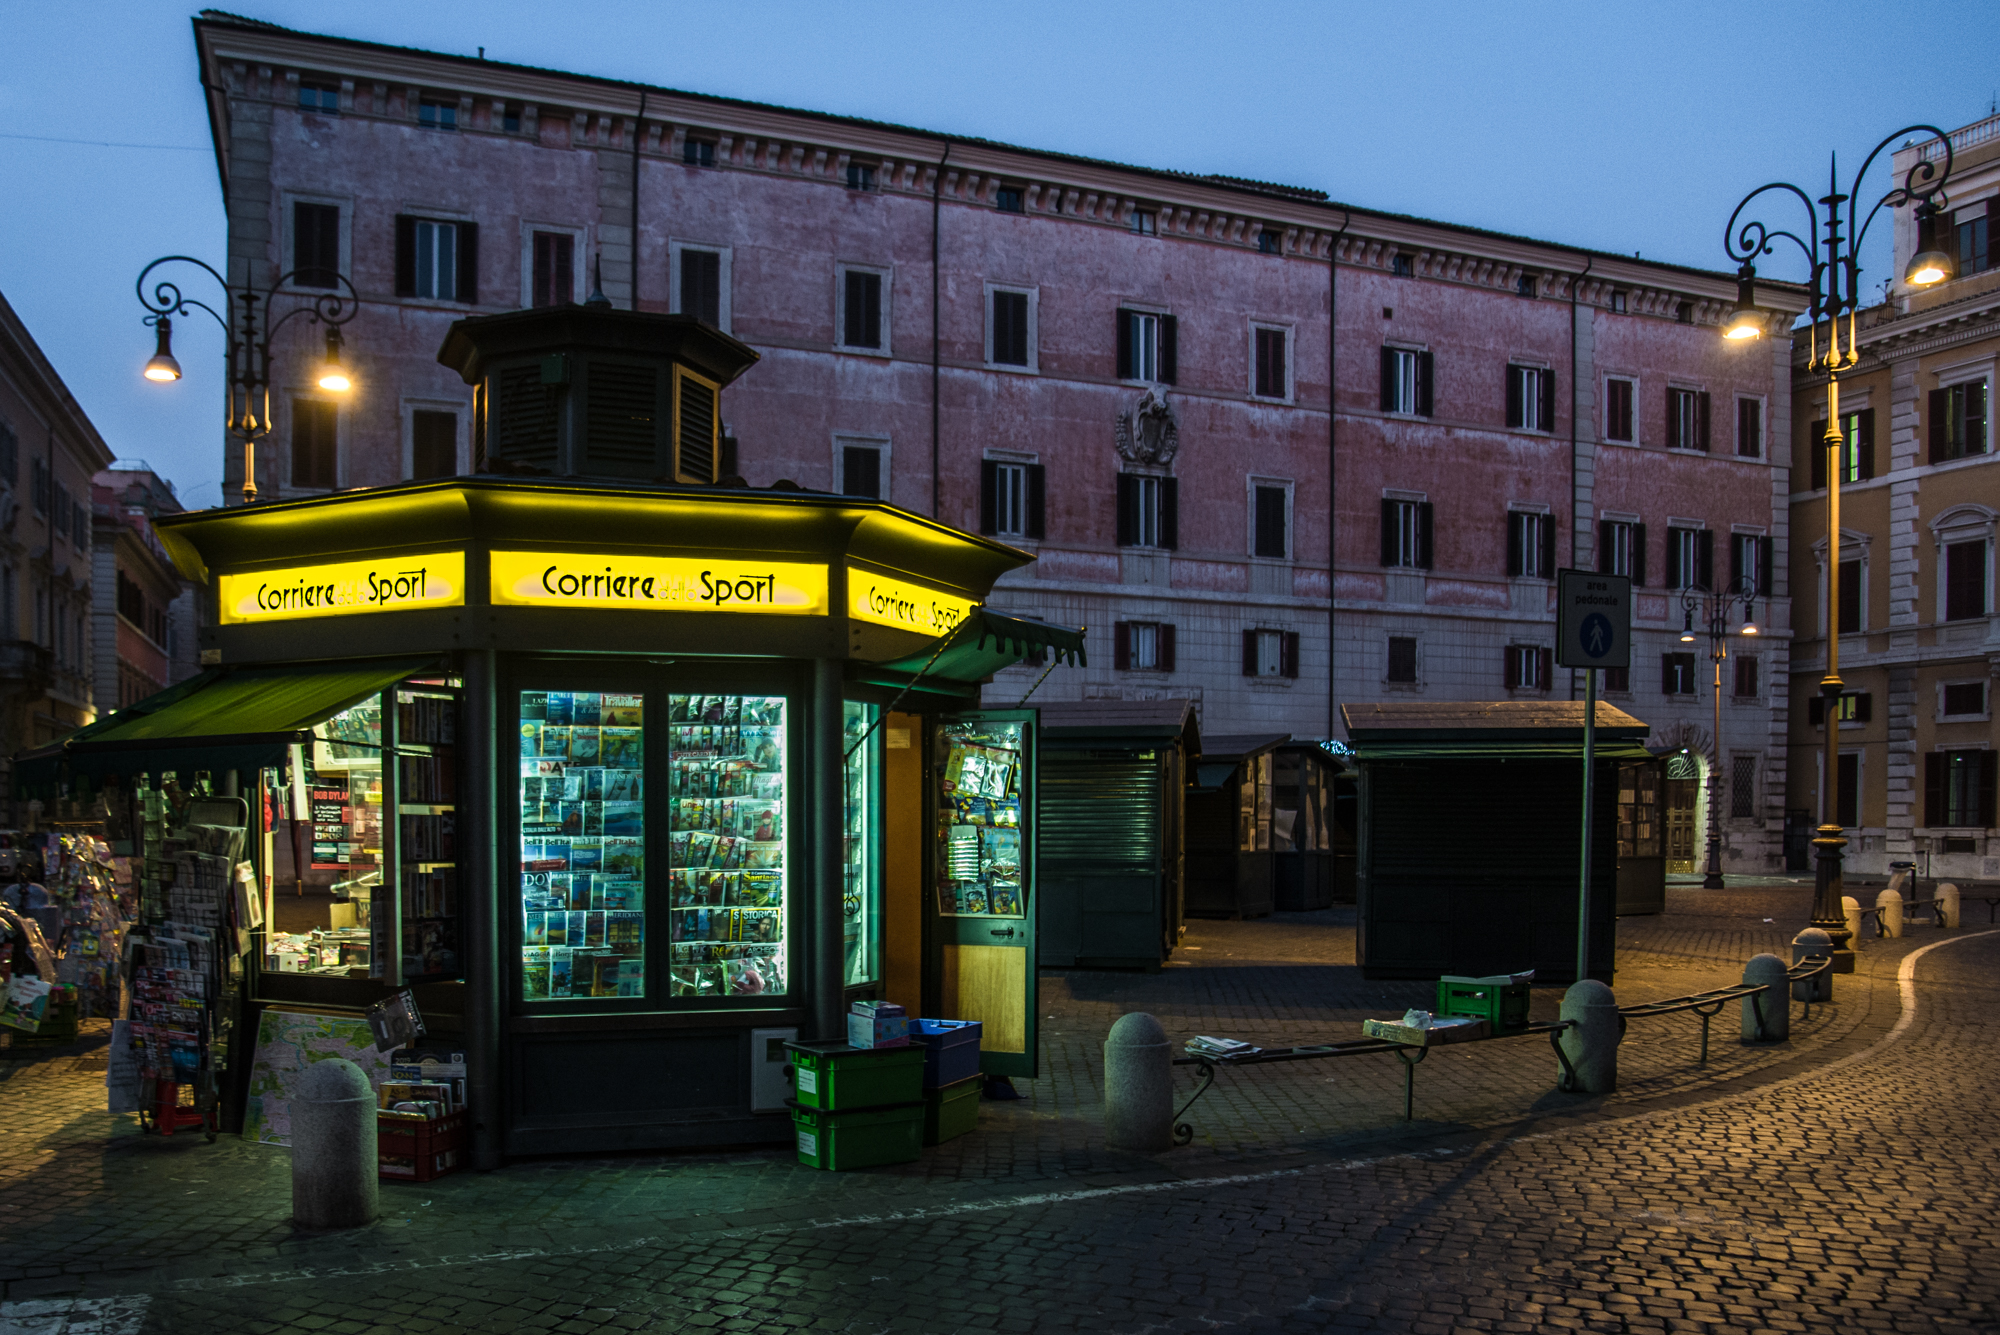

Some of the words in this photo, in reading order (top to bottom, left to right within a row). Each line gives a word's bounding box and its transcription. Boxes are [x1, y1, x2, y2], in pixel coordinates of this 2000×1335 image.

[258, 578, 334, 611] Corriere
[368, 567, 427, 606] Sport
[542, 565, 655, 599] Corriere
[700, 570, 775, 606] Sport
[1586, 581, 1608, 591] area
[1575, 595, 1619, 606] pedonale
[869, 585, 915, 622] Corriere
[931, 601, 960, 632] Sport
[604, 696, 642, 708] Traveller
[313, 791, 328, 800] BOB
[743, 872, 780, 881] Santiago
[743, 911, 778, 921] STORICA
